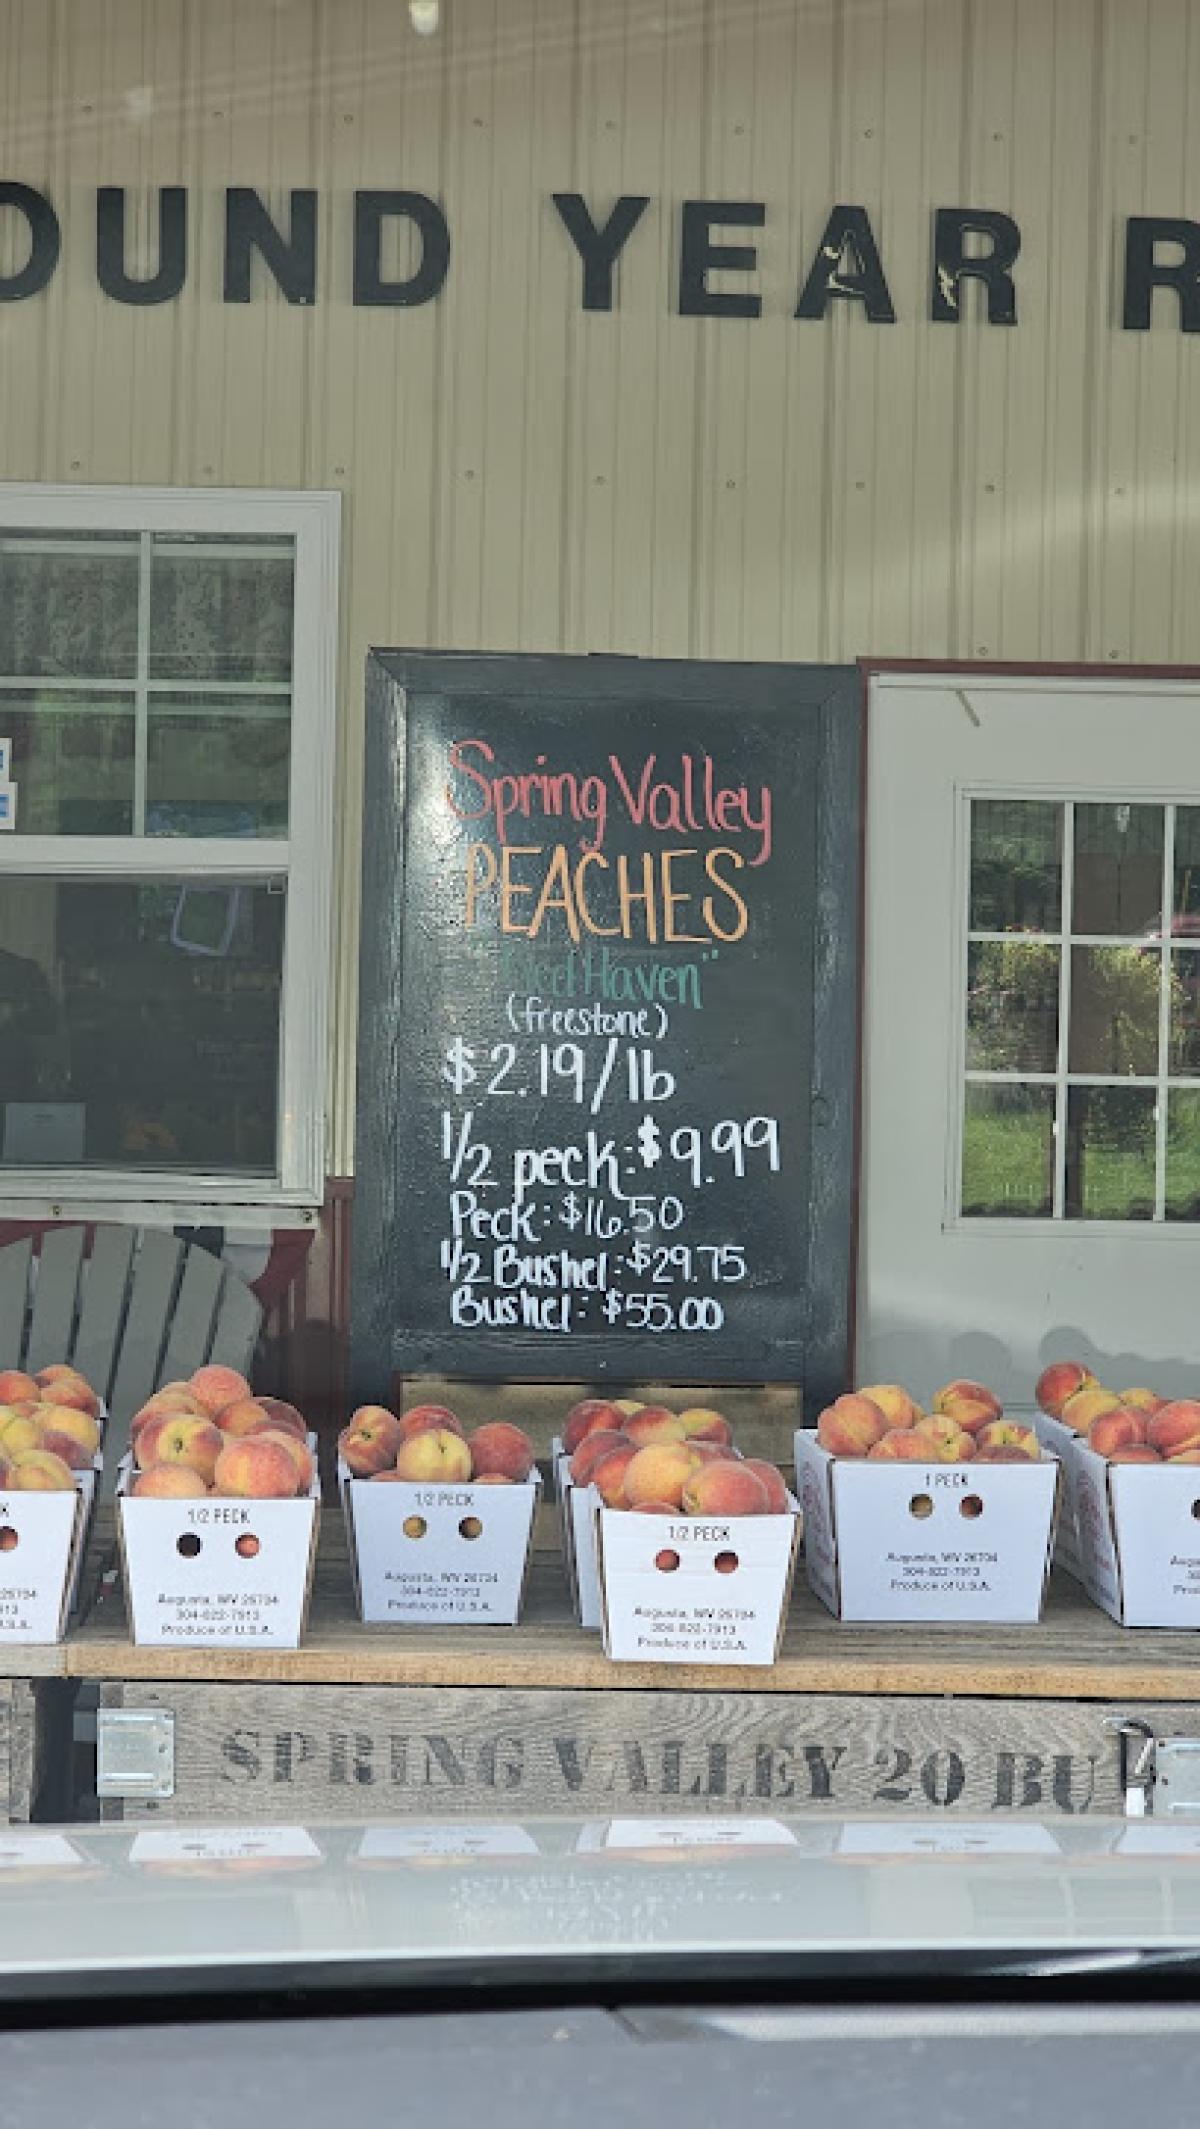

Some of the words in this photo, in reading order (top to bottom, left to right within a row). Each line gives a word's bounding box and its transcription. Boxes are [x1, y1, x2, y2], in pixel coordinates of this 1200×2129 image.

[0, 181, 451, 307] OUND
[551, 193, 1019, 327] YEAR
[1122, 216, 1200, 333] R
[446, 739, 607, 854] Spring
[608, 753, 772, 866] Valley
[463, 843, 749, 944] PEACHES
[505, 992, 669, 1039] (freestone)
[442, 1037, 676, 1115] $2.19/lb
[442, 1110, 499, 1186] 1/2
[450, 1190, 552, 1242] Peck:
[558, 1190, 684, 1239] $16.50
[440, 1238, 492, 1284] 1/2
[626, 1238, 748, 1285] $29.75
[602, 1287, 725, 1333] $55.00
[414, 1492, 436, 1507] 1/2
[438, 1492, 475, 1507] PECK
[934, 1473, 969, 1488] PECK
[188, 1508, 210, 1525] 1/2
[214, 1508, 251, 1525] PECK
[668, 1526, 689, 1542] 1/2
[693, 1526, 731, 1542] PECK
[220, 1728, 525, 1788] SPRING
[552, 1734, 847, 1799] VALLEY
[873, 1747, 967, 1807] 20
[991, 1751, 1097, 1814] BU
